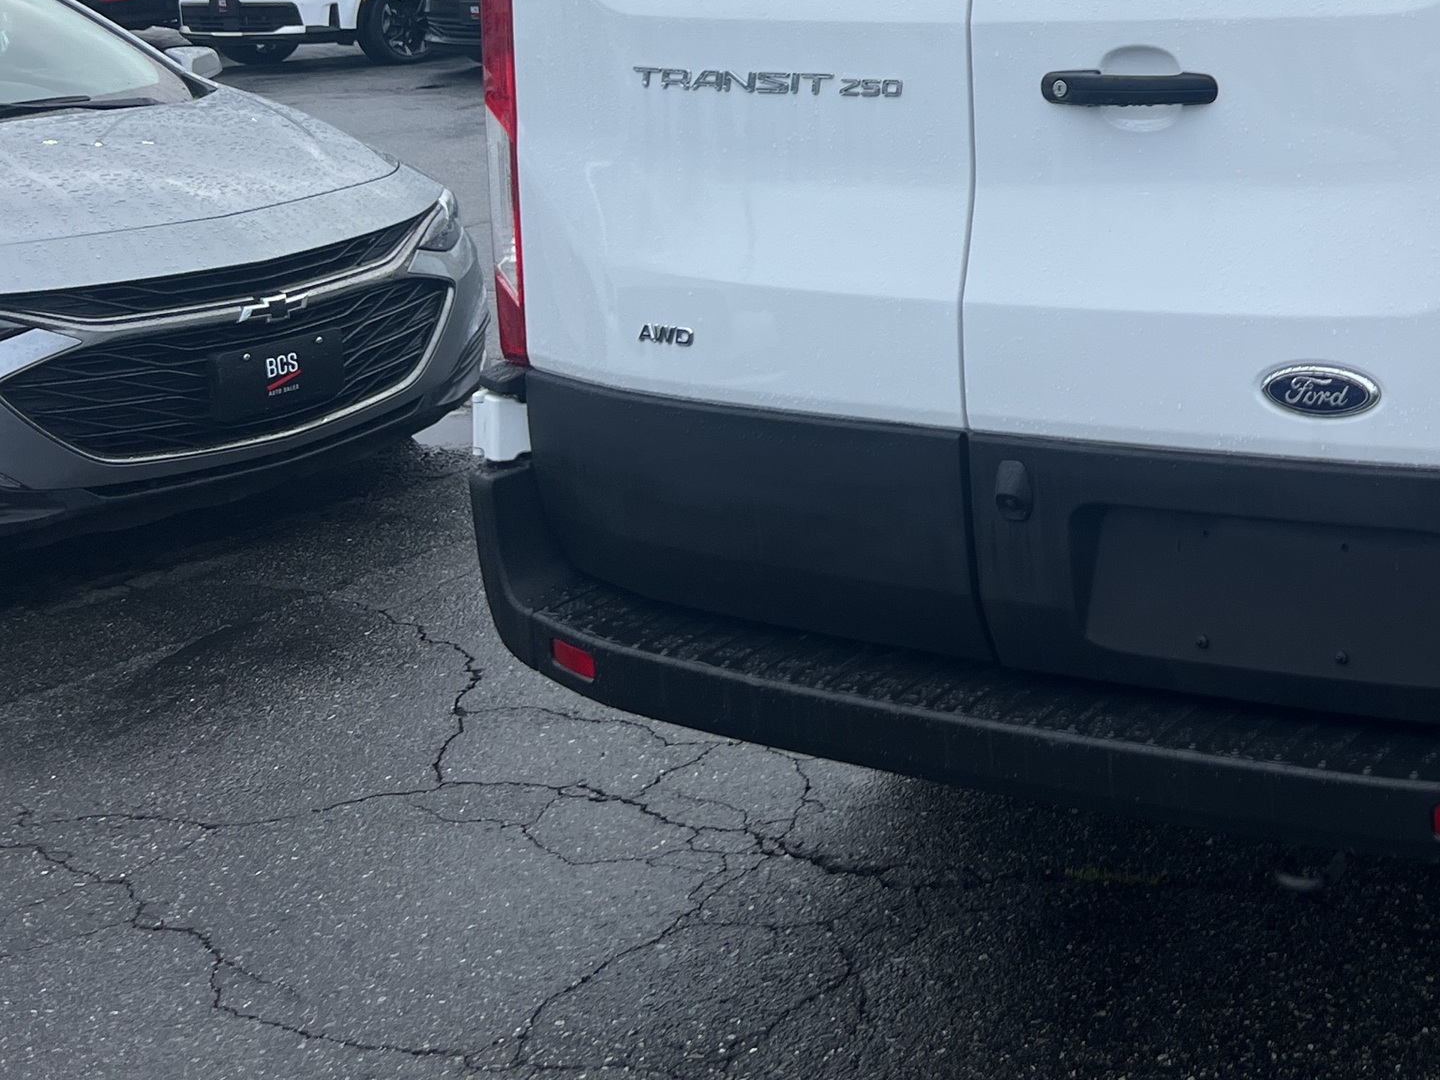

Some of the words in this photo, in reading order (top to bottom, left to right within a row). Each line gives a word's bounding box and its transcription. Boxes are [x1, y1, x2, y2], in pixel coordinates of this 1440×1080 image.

[632, 66, 834, 96] TRANSIT
[839, 78, 904, 98] 250
[639, 323, 694, 347] AWD
[266, 352, 299, 378] BCS
[268, 387, 282, 397] AUTO
[1285, 376, 1350, 406] Ford
